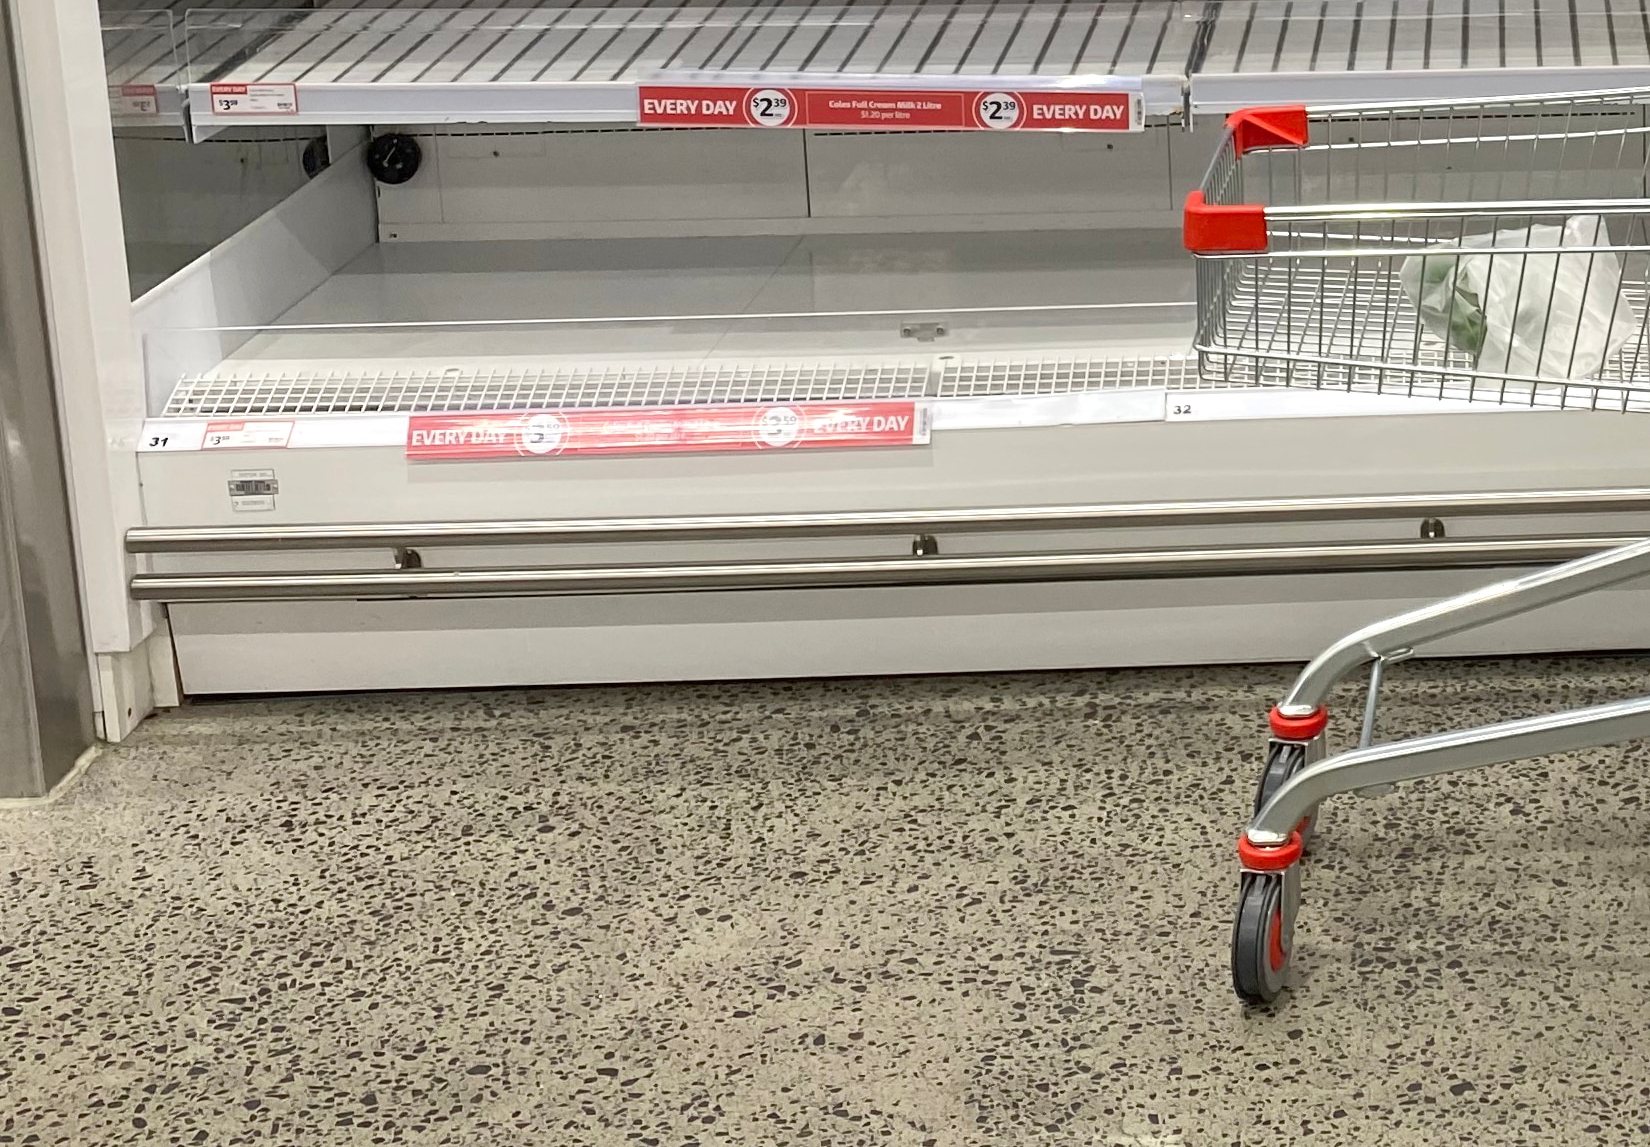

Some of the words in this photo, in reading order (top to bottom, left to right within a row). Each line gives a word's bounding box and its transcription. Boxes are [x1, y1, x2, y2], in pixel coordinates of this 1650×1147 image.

[643, 99, 699, 115] EVERY
[702, 100, 737, 116] DAY
[829, 100, 851, 109] Coles
[851, 100, 868, 109] Full
[868, 100, 895, 109] Cream
[896, 101, 916, 110] Milk
[916, 101, 922, 110] 2
[922, 101, 942, 110] Litre
[881, 112, 894, 121] per
[894, 110, 911, 120] litre
[1032, 104, 1086, 120] EVERY
[1089, 105, 1125, 120] DAY
[1173, 404, 1192, 415] 32
[812, 415, 870, 433] EVERY
[872, 415, 910, 431] DAY
[149, 437, 169, 447] 31
[411, 429, 466, 447] EVERY
